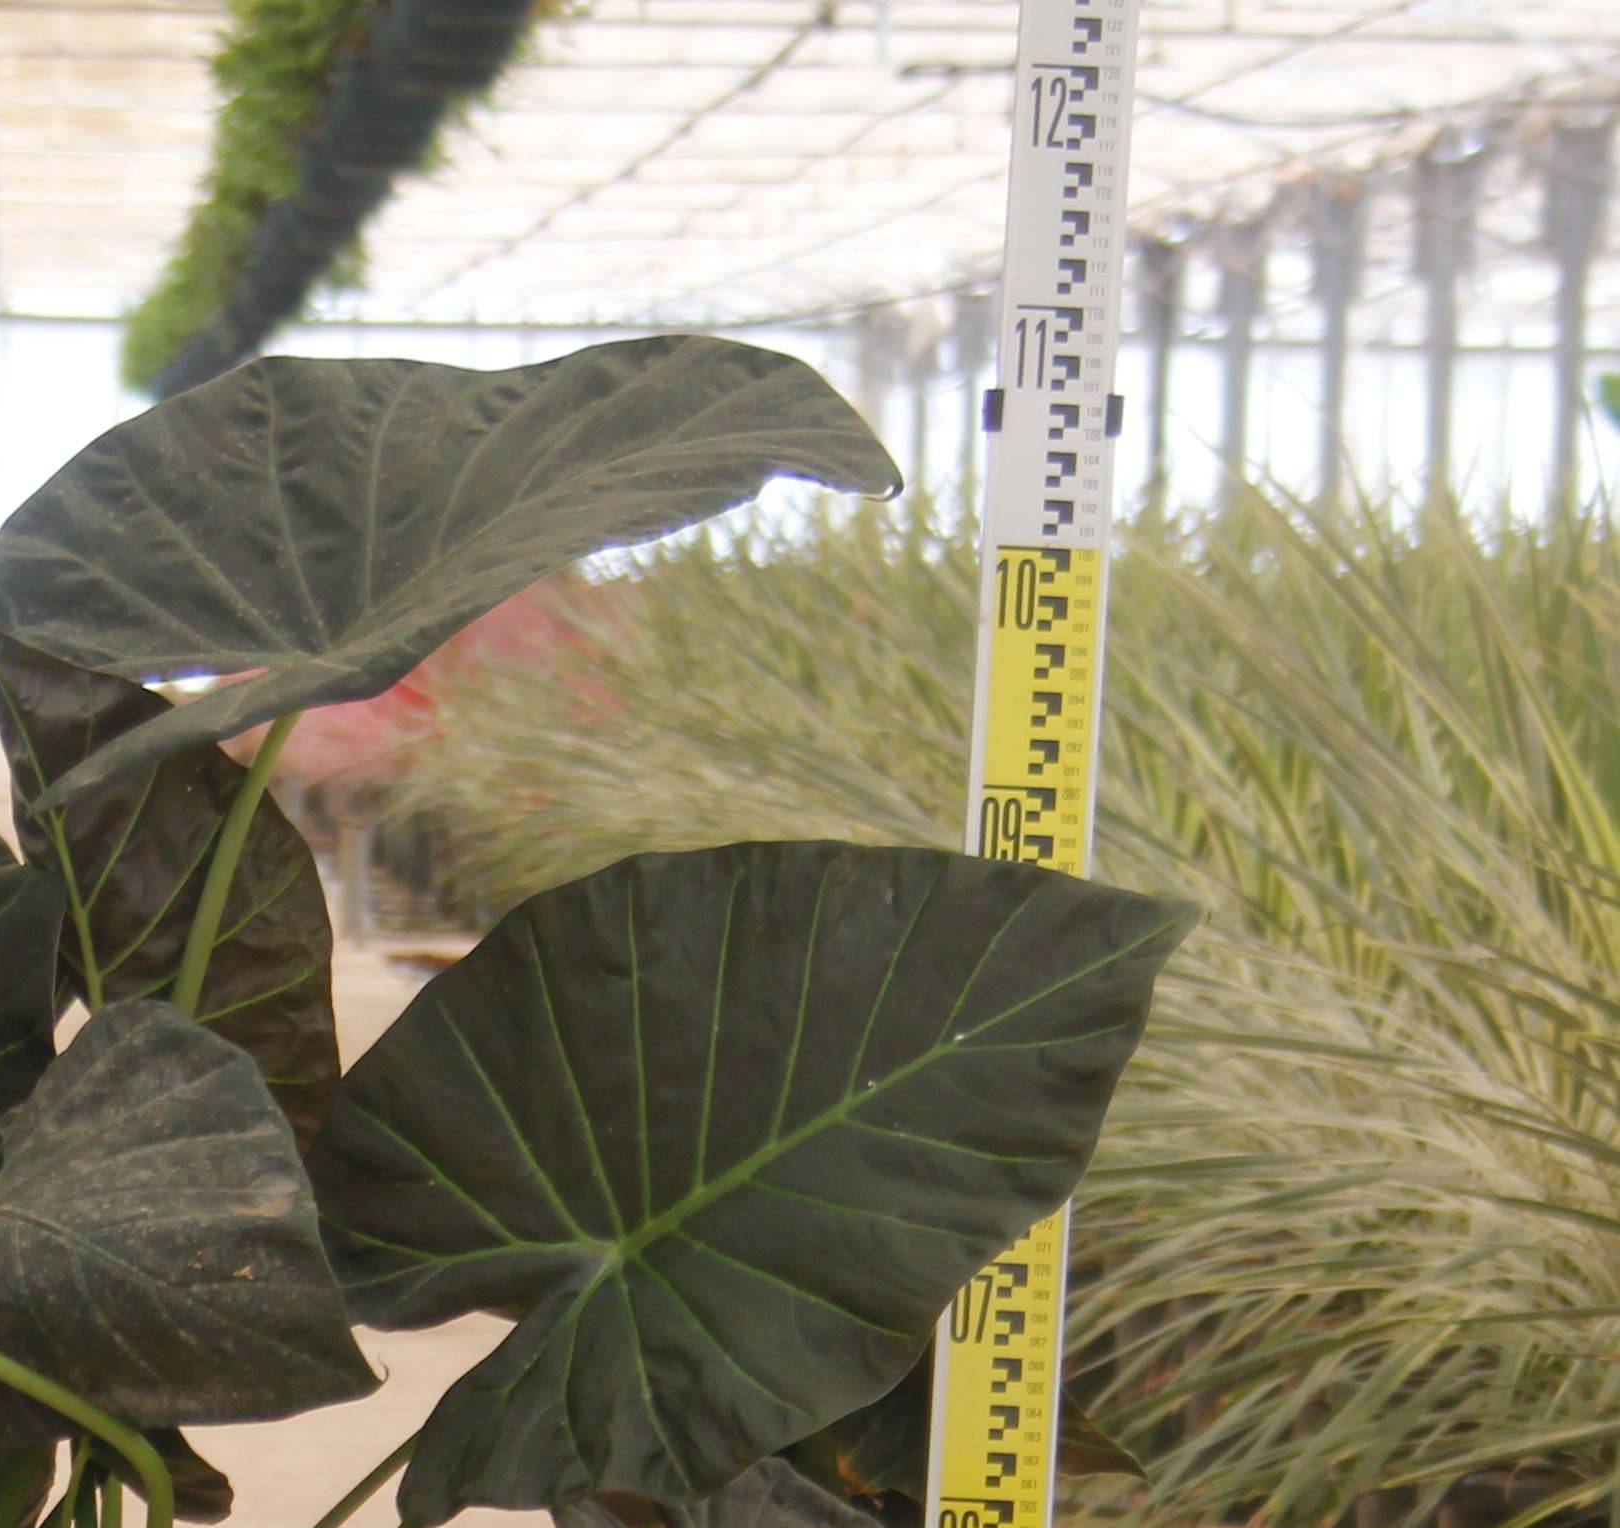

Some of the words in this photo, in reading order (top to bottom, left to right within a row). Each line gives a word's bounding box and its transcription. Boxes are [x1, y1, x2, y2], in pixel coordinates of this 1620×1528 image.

[1031, 77, 1067, 148] 12
[1016, 318, 1047, 389] 11
[996, 559, 1036, 630] 10
[979, 796, 1021, 862] 09
[951, 1275, 993, 1344] 07
